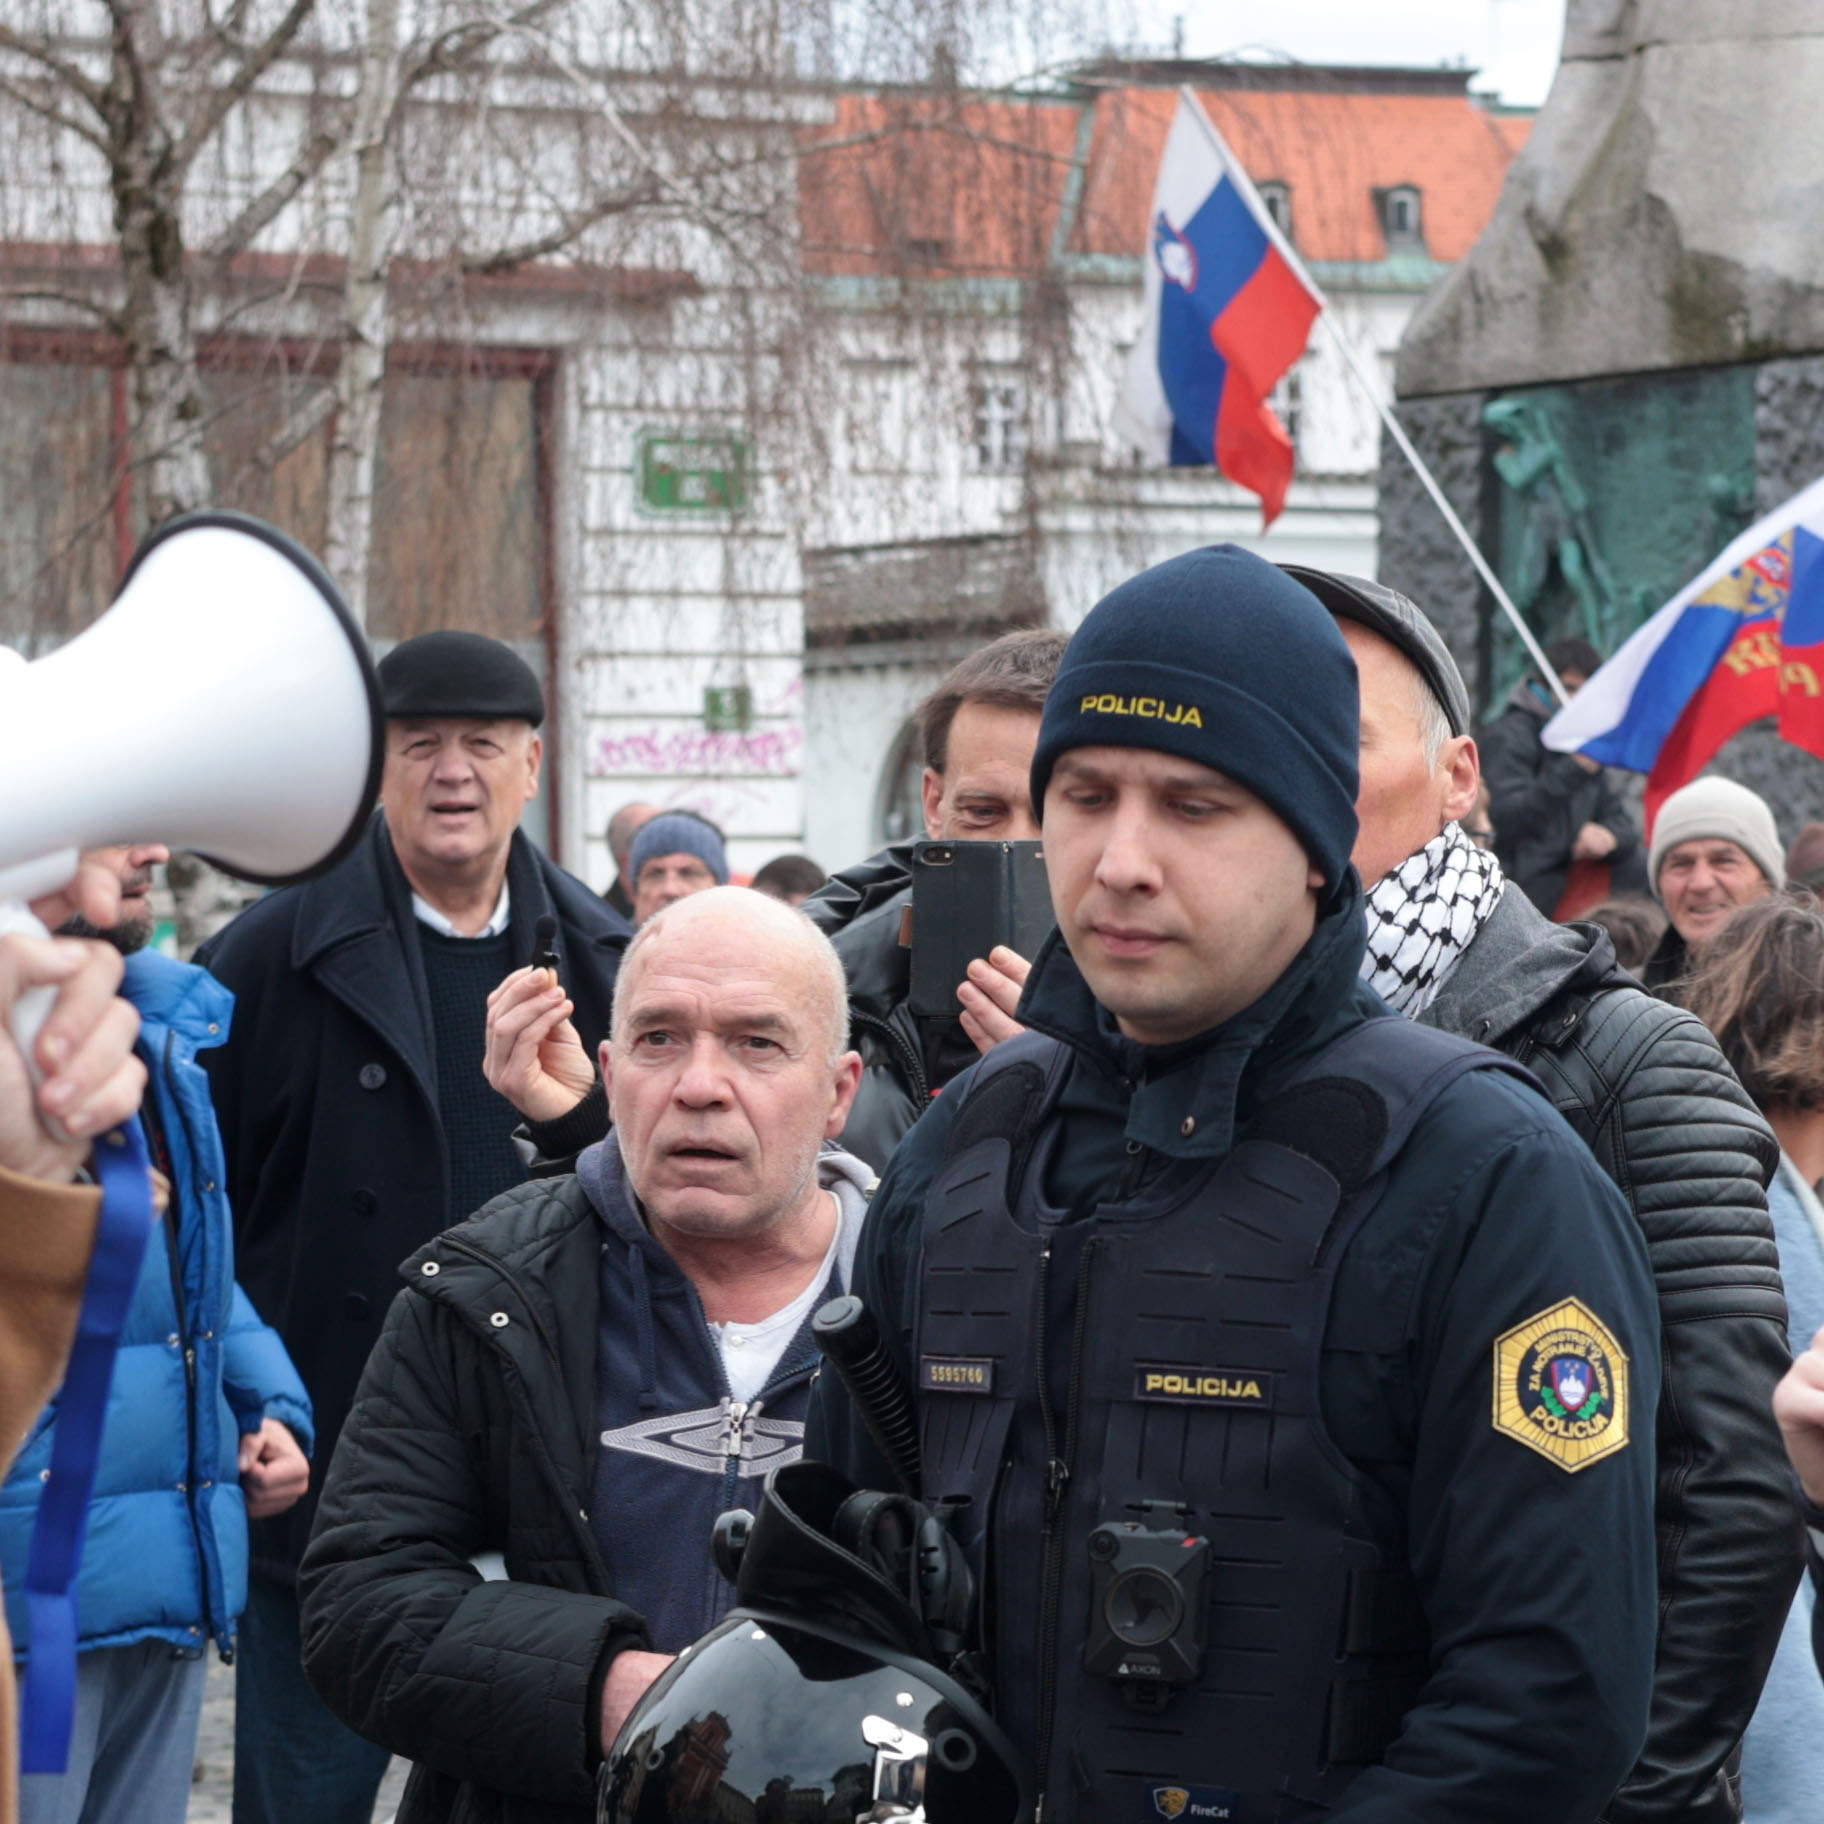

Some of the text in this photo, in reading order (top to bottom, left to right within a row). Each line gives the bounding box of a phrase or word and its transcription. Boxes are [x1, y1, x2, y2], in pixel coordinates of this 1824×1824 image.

[1080, 694, 1203, 729] POLICIJA
[1145, 1374, 1263, 1398] POLICIJA
[1530, 1404, 1609, 1438] POLICIJA
